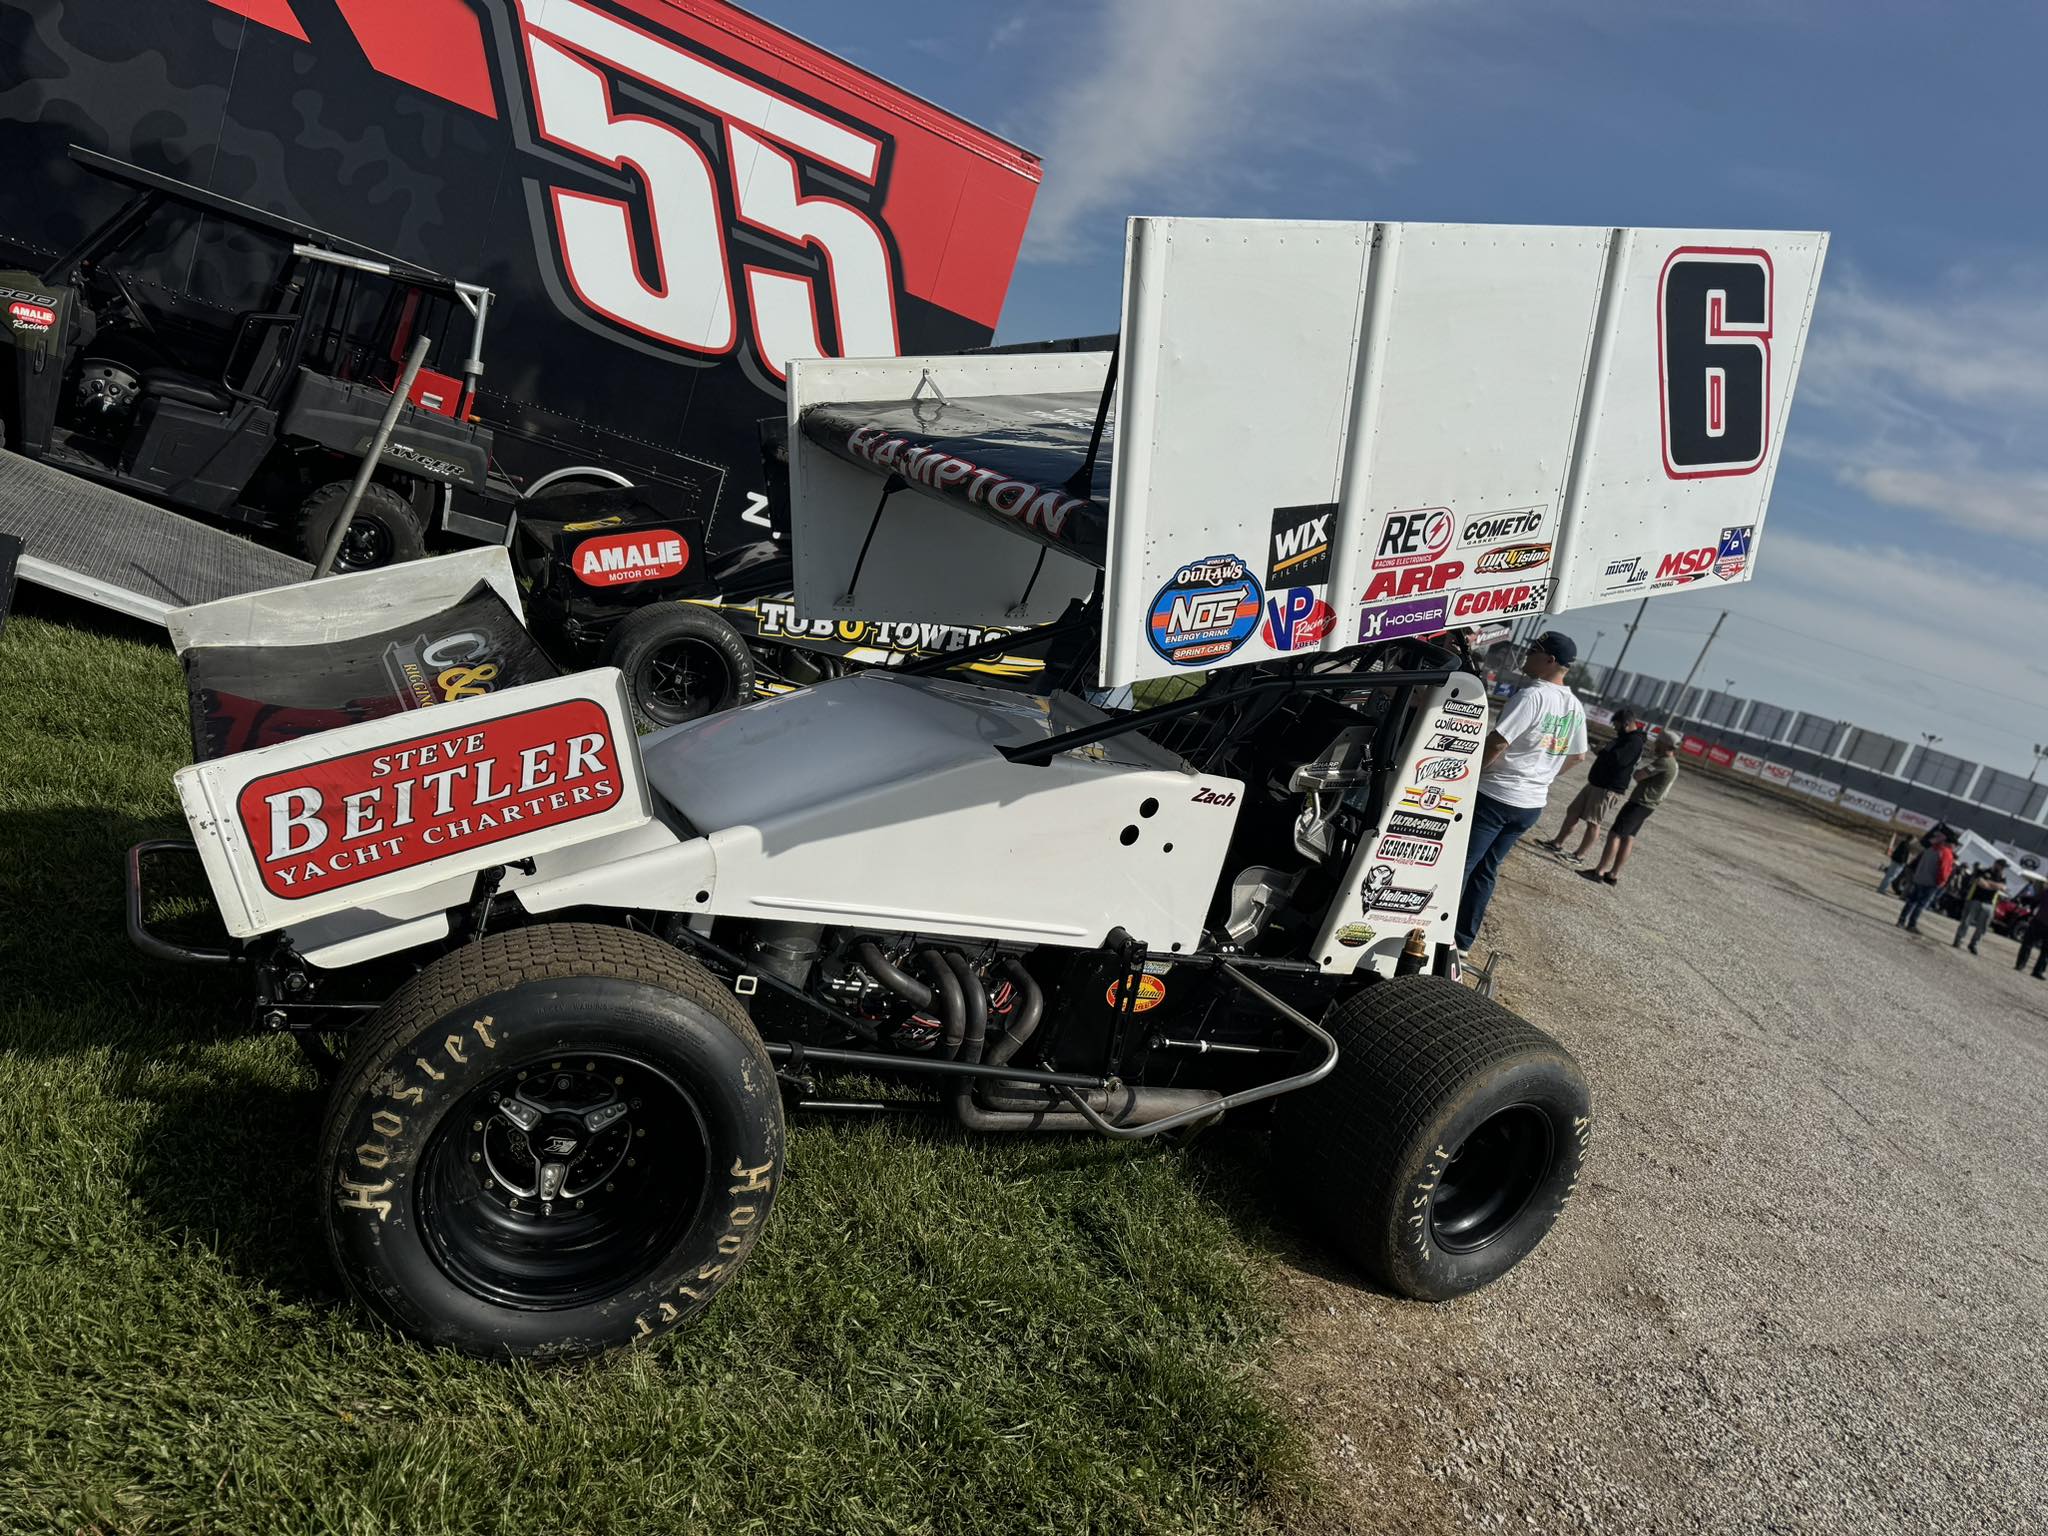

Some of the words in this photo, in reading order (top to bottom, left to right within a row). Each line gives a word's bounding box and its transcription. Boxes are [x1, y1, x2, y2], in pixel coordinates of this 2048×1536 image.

[514, 0, 901, 381] 55
[12, 305, 53, 321] AMALIE
[12, 319, 49, 333] Racing
[1663, 253, 1770, 475] 6
[847, 428, 1092, 538] HAMPTON
[1275, 513, 1329, 561] WIX
[1463, 514, 1542, 540] COMETIC
[582, 540, 682, 574] AMALIE
[1271, 552, 1327, 581] FILTERS
[1655, 547, 1717, 579] MSD
[608, 569, 642, 582] MOTOR
[644, 567, 660, 577] OIL
[1361, 561, 1464, 601] ARP
[1167, 585, 1249, 634] NOS
[1454, 586, 1530, 616] COMP
[1503, 601, 1538, 614] CAMS
[1267, 586, 1314, 650] VP
[1295, 615, 1337, 642] Racing
[1386, 609, 1442, 627] HOOSIER
[1165, 632, 1201, 644] ENERGY
[1202, 628, 1229, 638] DRINK
[1174, 647, 1205, 658] SPRINT
[1207, 643, 1231, 654] CARS
[1435, 717, 1483, 736] wilwood
[373, 732, 486, 778] STEVE
[264, 732, 610, 863] BEITLER
[1192, 787, 1236, 807] Zach
[276, 836, 406, 887] YACHT
[422, 779, 614, 846] CHARTERS
[1380, 839, 1439, 863] SCHOENFELD
